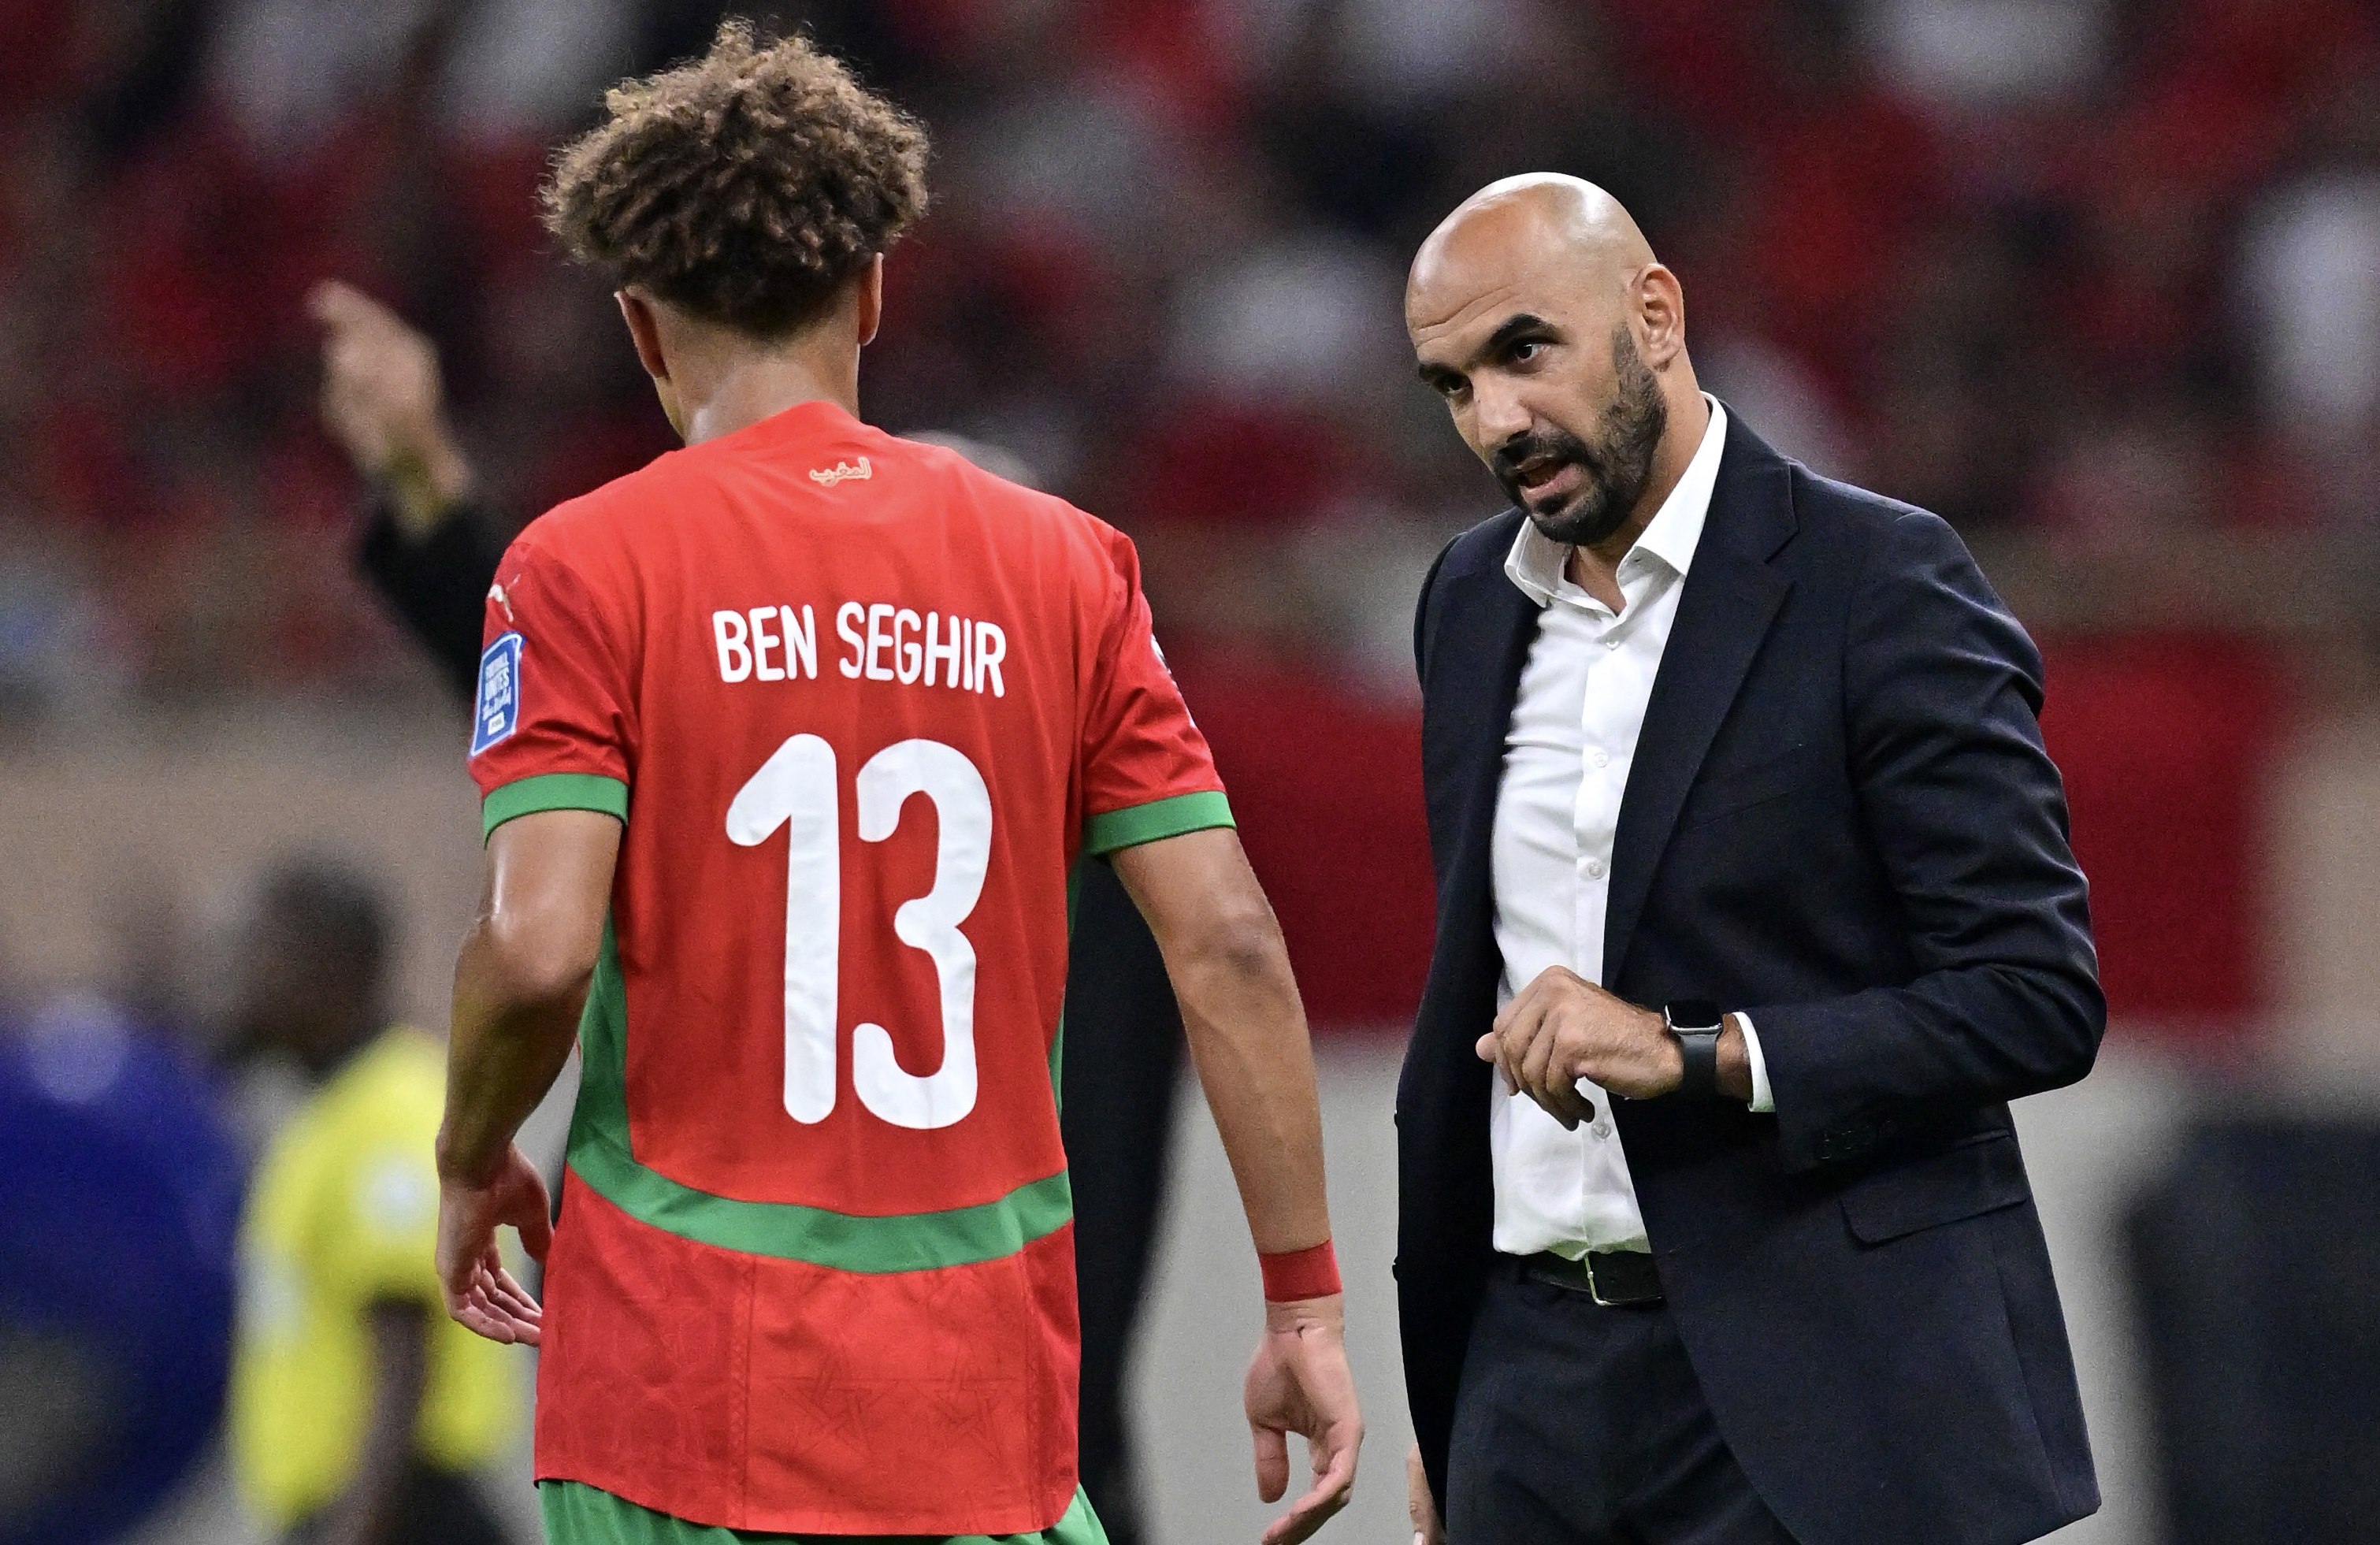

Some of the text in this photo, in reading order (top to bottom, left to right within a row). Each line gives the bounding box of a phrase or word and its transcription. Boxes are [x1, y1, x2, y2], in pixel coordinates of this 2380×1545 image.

[809, 456, 872, 487] المغرب
[712, 601, 1007, 698] BEN SEGHIR
[726, 733, 993, 1130] 13
